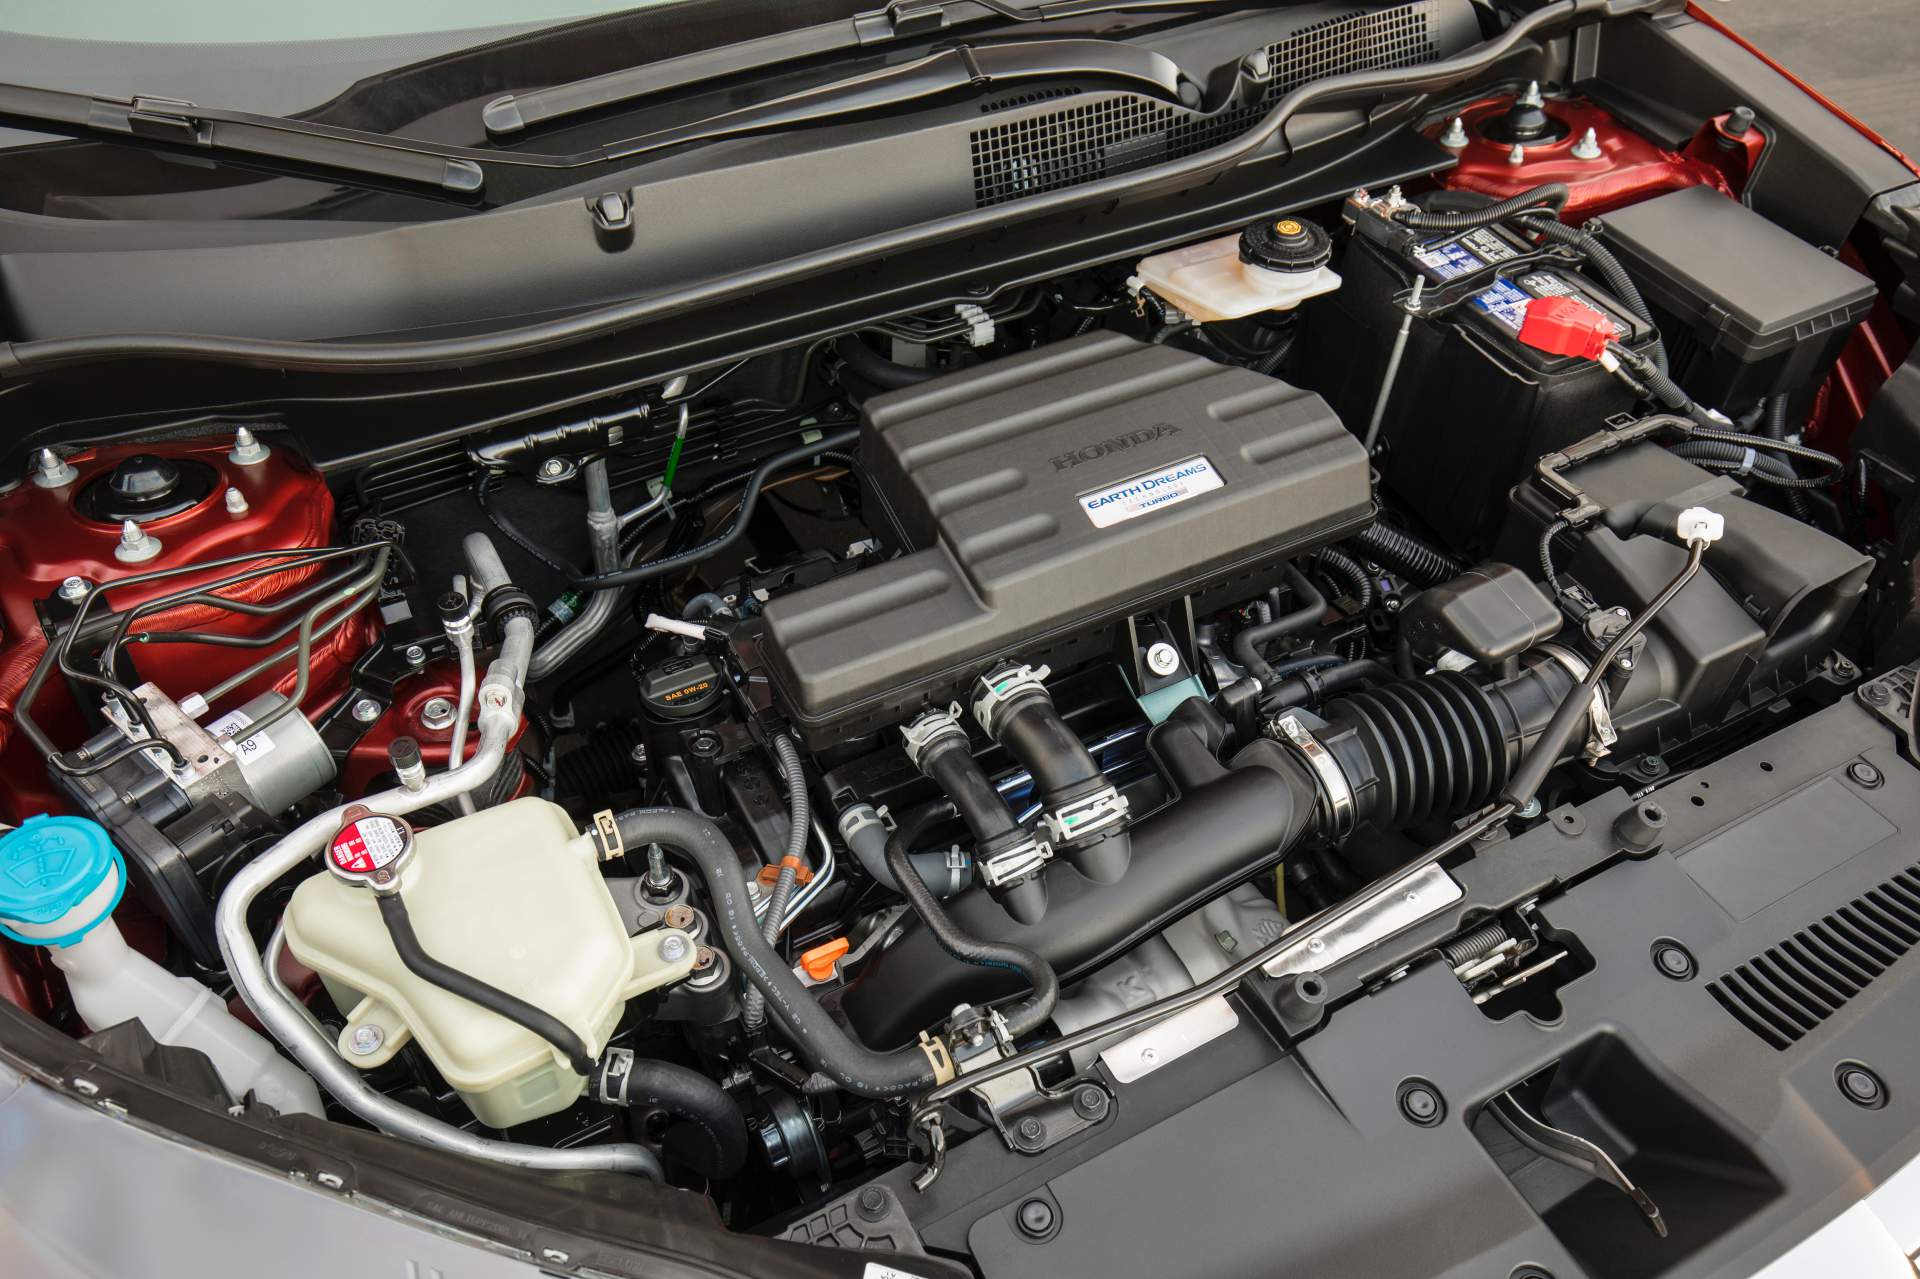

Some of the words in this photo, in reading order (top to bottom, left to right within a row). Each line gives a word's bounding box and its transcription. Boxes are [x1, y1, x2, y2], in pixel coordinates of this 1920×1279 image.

[1049, 422, 1182, 472] HONDA
[1087, 483, 1141, 509] EARTH
[1142, 463, 1207, 491] DREAMS
[1139, 492, 1179, 509] TURBO
[664, 690, 682, 701] SAE
[683, 682, 709, 695] 0W-20
[240, 739, 257, 756] A9
